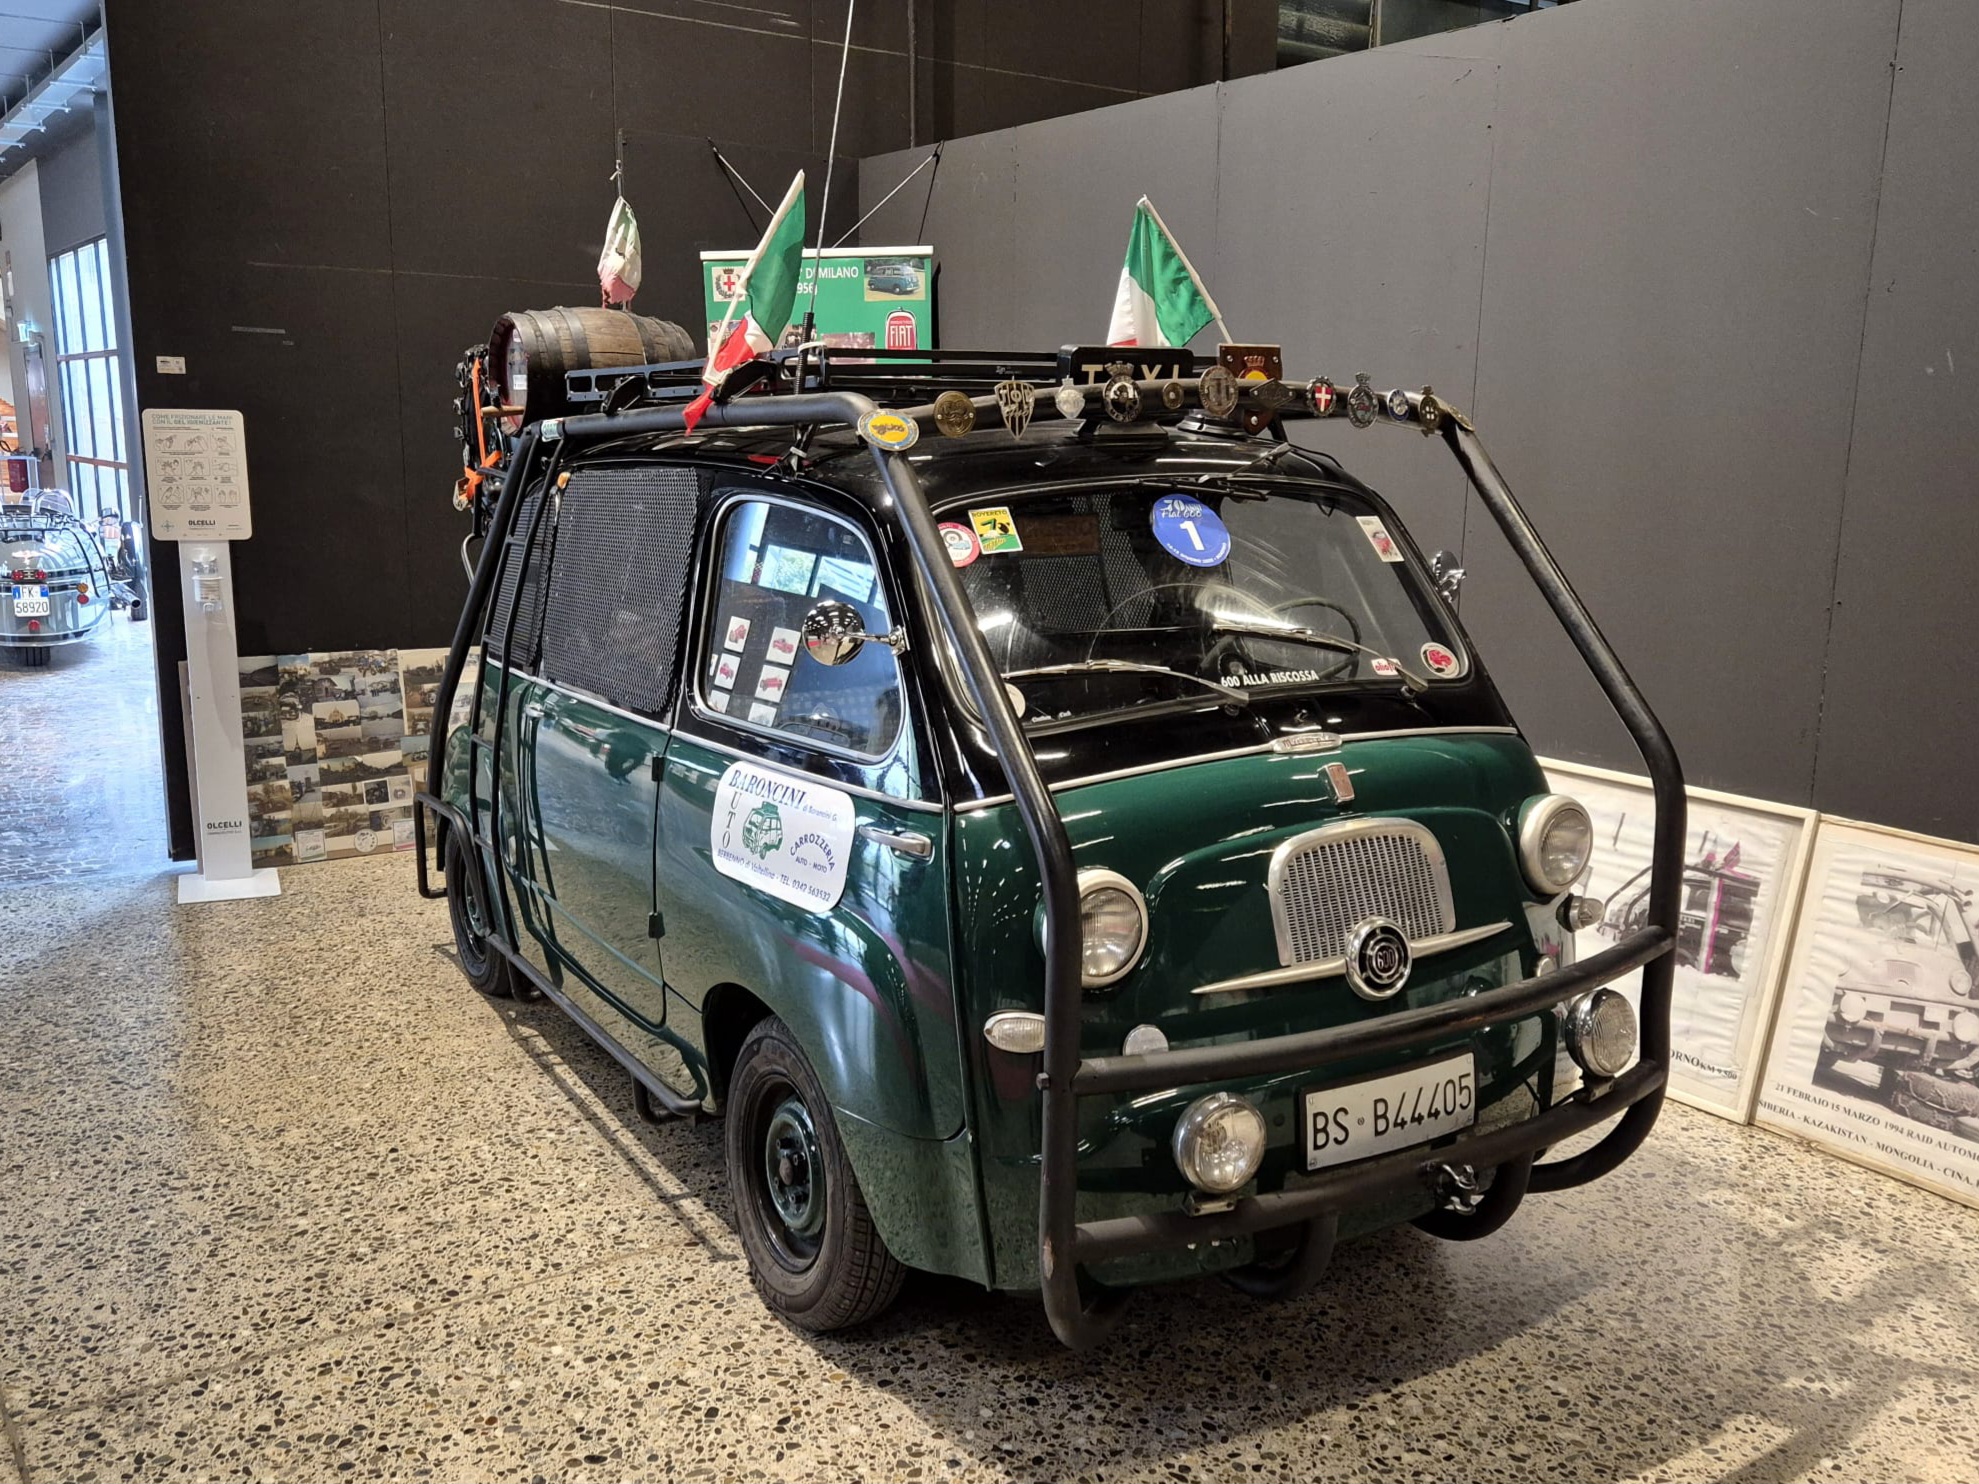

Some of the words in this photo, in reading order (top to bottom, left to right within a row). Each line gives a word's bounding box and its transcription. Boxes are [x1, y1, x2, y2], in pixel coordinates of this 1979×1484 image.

[818, 266, 859, 278] MILANO
[890, 325, 912, 346] FIAT
[971, 509, 1008, 517] ROVERETO
[1184, 510, 1202, 518] 600
[1180, 521, 1205, 550] 1
[22, 587, 34, 598] FK
[16, 601, 49, 614] 58920
[1221, 675, 1240, 688] 600
[1242, 673, 1270, 686] ALLA
[1269, 670, 1320, 683] RISCOSSA
[729, 769, 807, 810] BARONCINI
[206, 820, 242, 830] OLCELLI
[790, 833, 836, 872] CARROZZERIA
[795, 856, 808, 867] AUTO
[813, 862, 828, 874] MOTO
[1377, 949, 1395, 969] 600
[1313, 1107, 1349, 1151] BS
[1373, 1073, 1472, 1137] B44405
[1775, 1083, 1784, 1092] 21
[1787, 1086, 1829, 1108] FEBRAIO
[1831, 1102, 1841, 1112] 15
[1843, 1106, 1881, 1126] MARZO
[1884, 1121, 1905, 1135] 1994
[1906, 1129, 1934, 1145] RAID
[1758, 1100, 1796, 1120] SIBERIA
[1803, 1115, 1868, 1144] KAZAKISTAN
[1875, 1141, 1935, 1171] MONGOLIA
